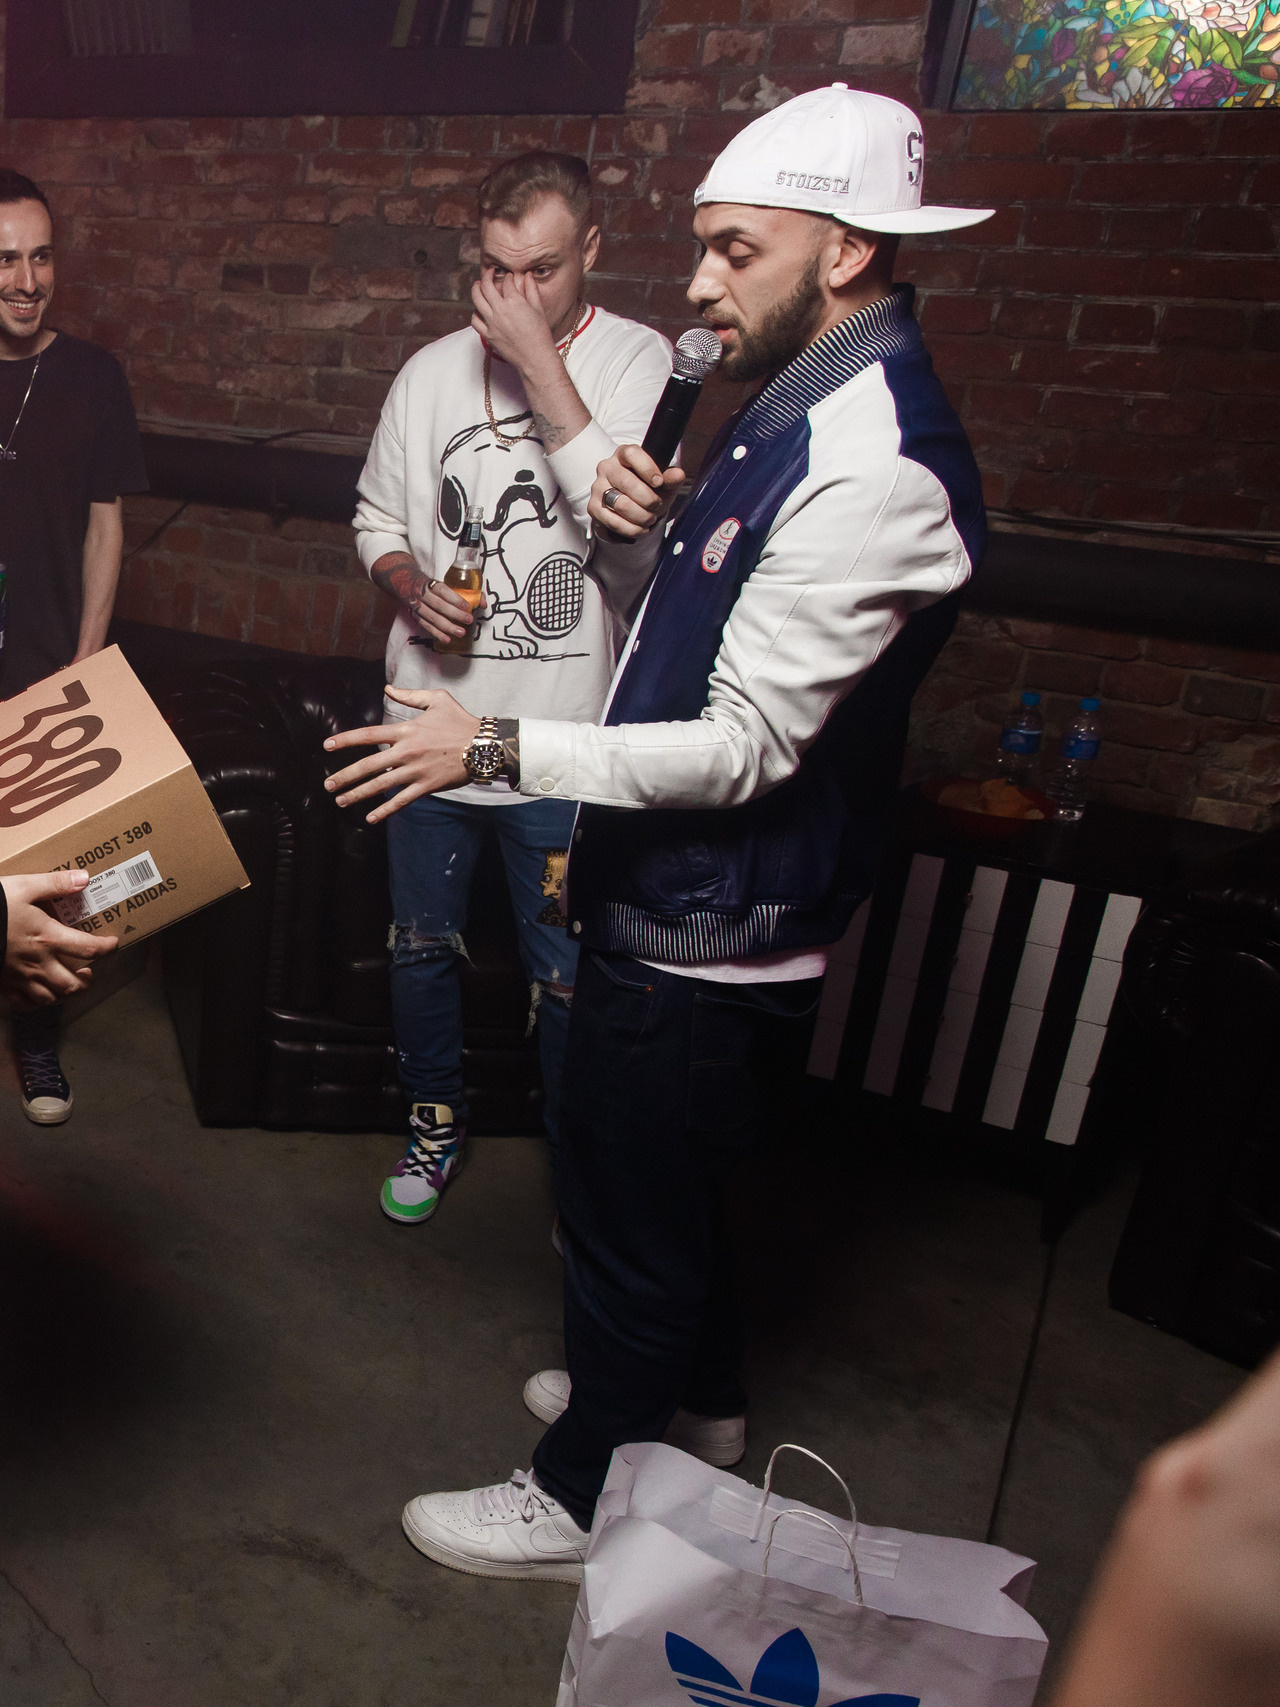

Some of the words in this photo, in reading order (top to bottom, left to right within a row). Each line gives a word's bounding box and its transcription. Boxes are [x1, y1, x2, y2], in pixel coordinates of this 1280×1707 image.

[74, 836, 122, 870] BOOST
[123, 821, 153, 844] 380
[102, 905, 122, 924] BY
[125, 877, 178, 913] ADIDAS
